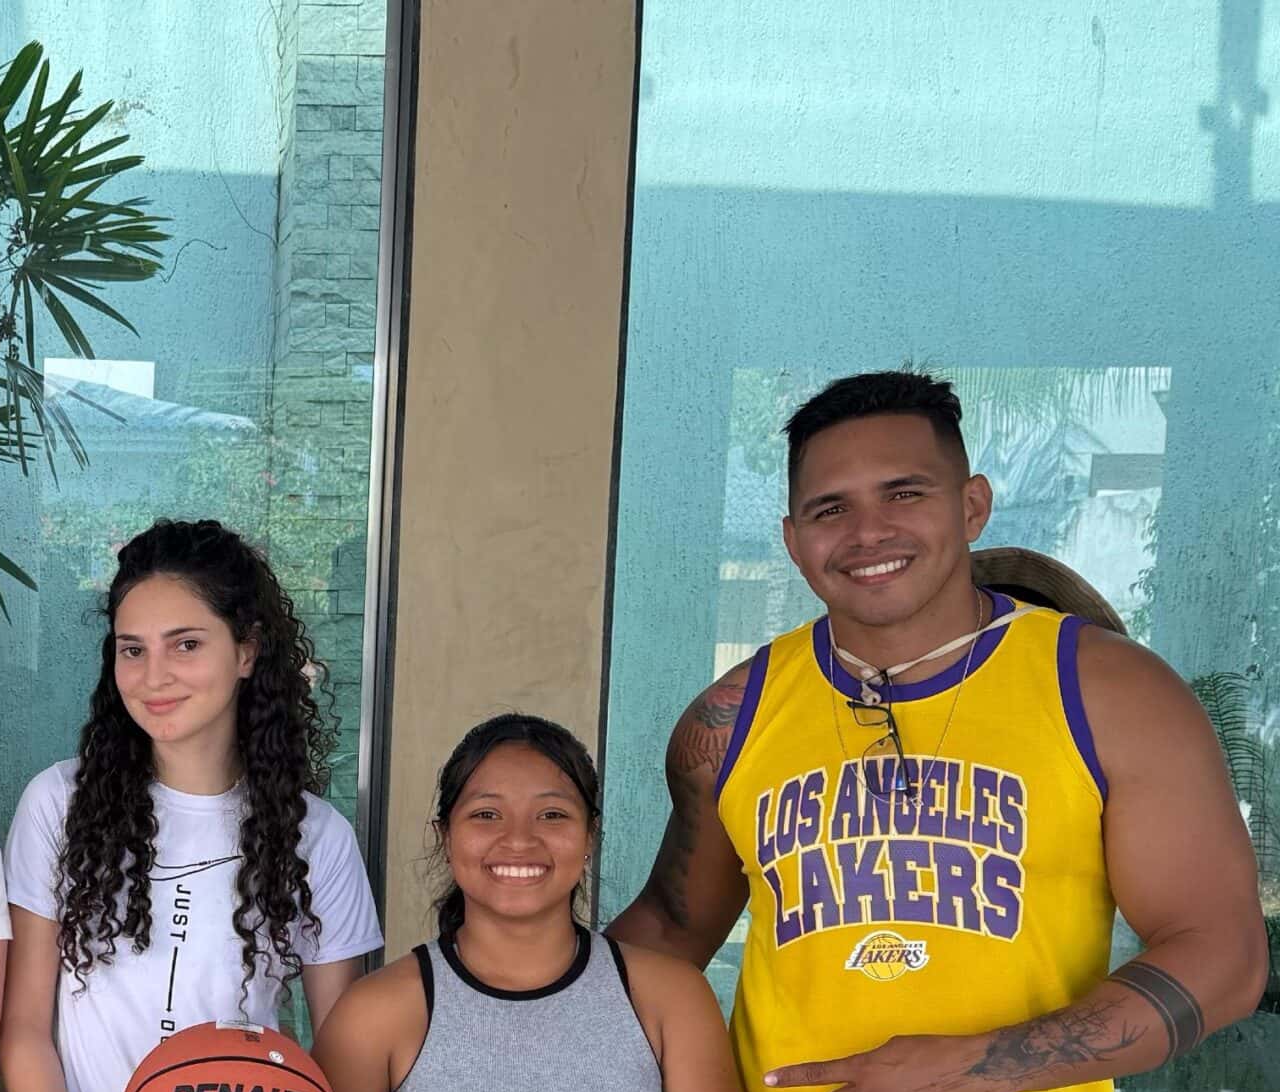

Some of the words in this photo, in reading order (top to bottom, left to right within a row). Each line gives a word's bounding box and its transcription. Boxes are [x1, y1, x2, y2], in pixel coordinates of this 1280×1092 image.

[755, 766, 827, 867] LOS
[828, 755, 1027, 857] ANGELES
[170, 884, 192, 942] JUST
[762, 837, 1025, 950] LAKERS
